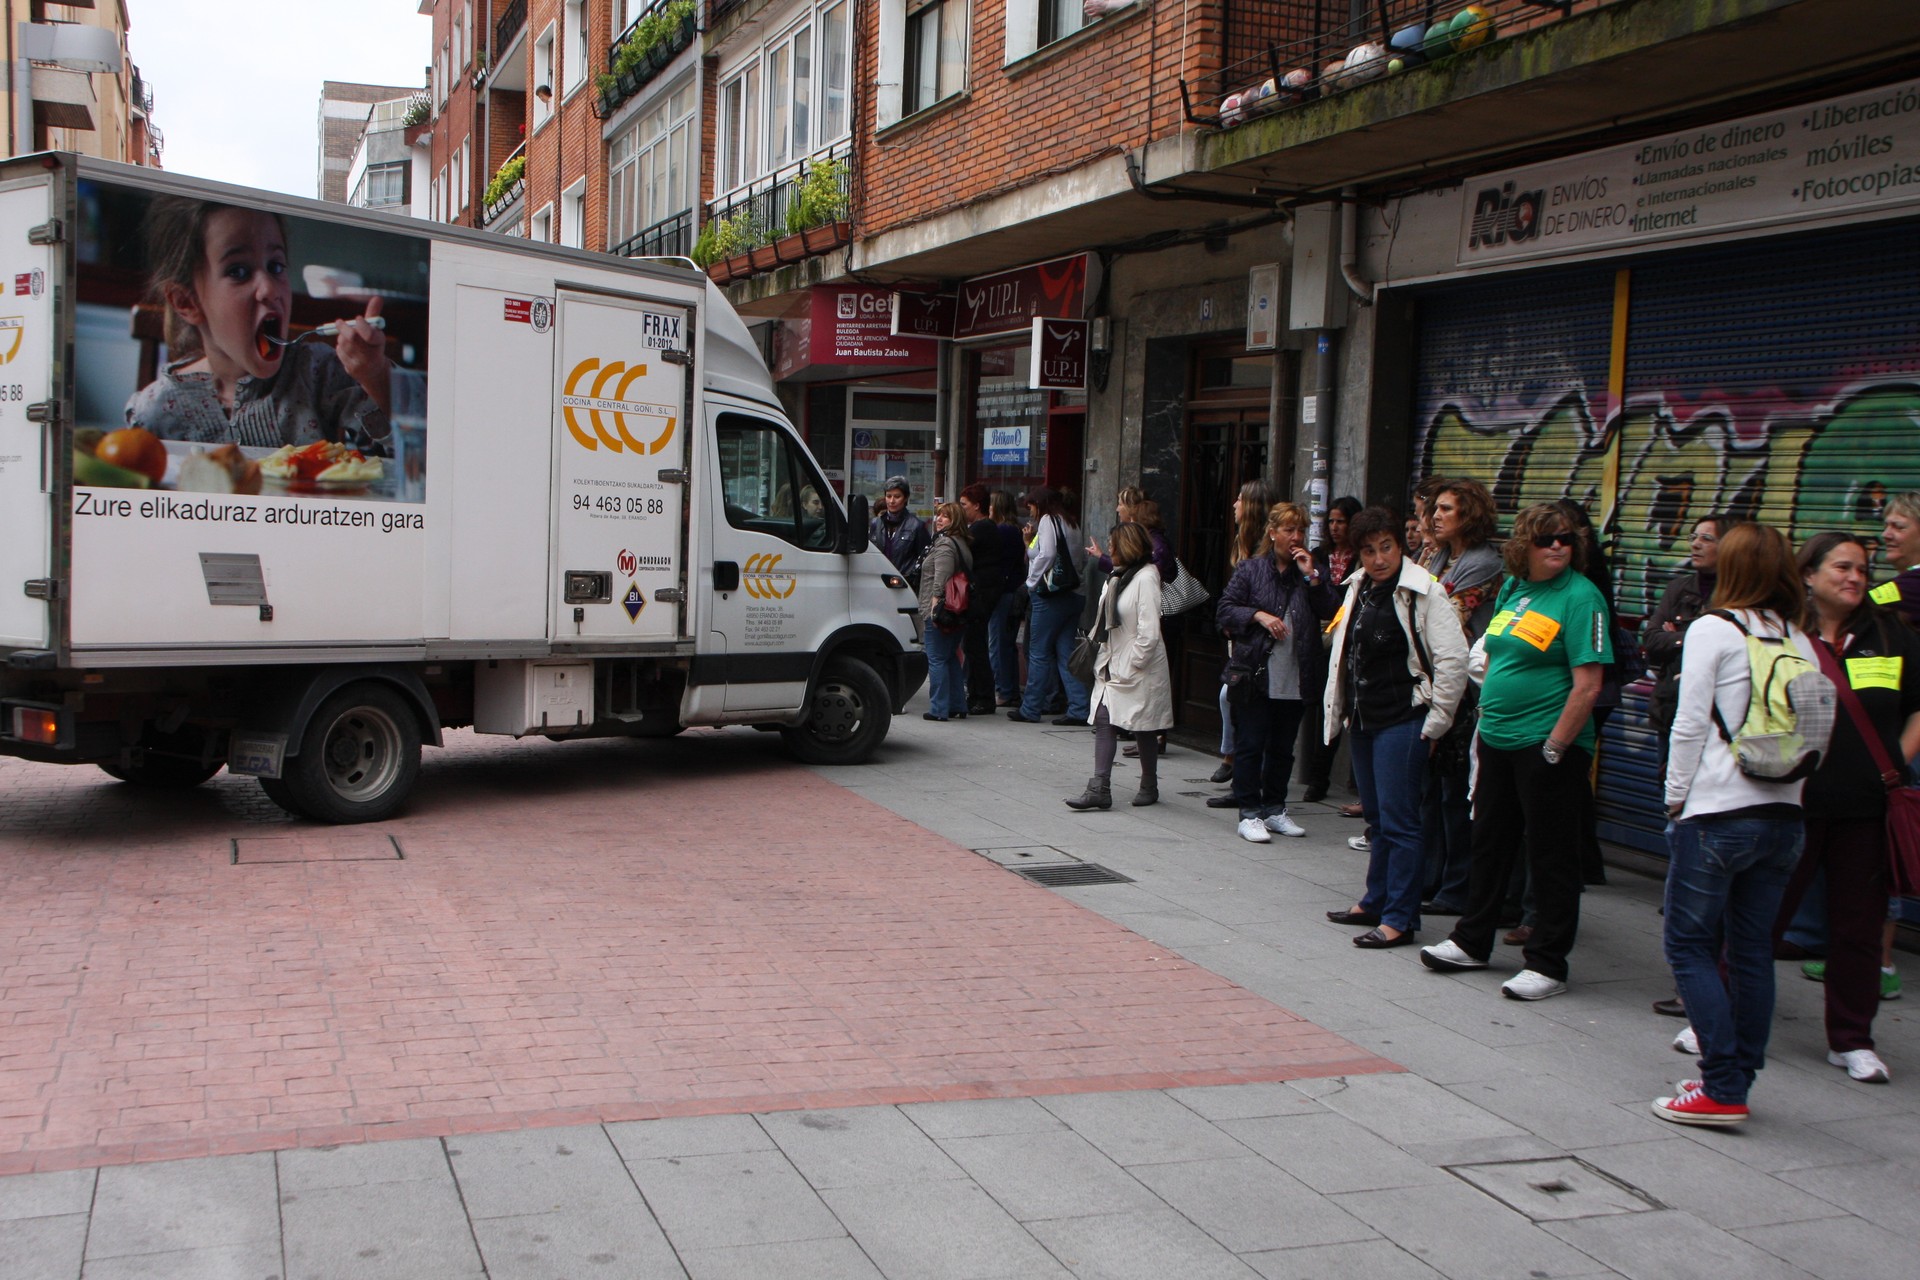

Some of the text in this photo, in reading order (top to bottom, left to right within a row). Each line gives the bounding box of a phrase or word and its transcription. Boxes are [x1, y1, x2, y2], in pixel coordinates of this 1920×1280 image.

[1811, 87, 1920, 131] Liberació
[1641, 122, 1785, 165] Envío de dinero
[1806, 134, 1893, 167] móviles
[1639, 147, 1788, 186] Llamadas nacionales
[1552, 175, 1608, 206] ENVÍOS
[1636, 175, 1756, 208] e Internacionales
[1545, 203, 1627, 236] DE DINERO
[1633, 205, 1698, 233] Internet
[988, 280, 1022, 318] U.P.I.
[1203, 300, 1209, 317] 6
[644, 313, 680, 338] FRAX
[647, 337, 673, 350] 01-2012
[835, 348, 909, 357] Juan Bautista Zabala
[1044, 360, 1083, 378] U.P.I.
[11, 385, 23, 401] 88
[563, 397, 592, 406] COCINA
[597, 401, 630, 411] CENTRAL
[991, 428, 1015, 446] Pelikan
[991, 452, 1020, 463] Consumibles
[627, 482, 664, 490] SUKALDARITZA
[74, 492, 424, 533] Zure elikaduraz arduratzen gara
[573, 494, 663, 514] 94 463 05 88
[620, 556, 634, 571] M
[639, 557, 671, 565] MONDRAGON
[629, 592, 638, 601] BI
